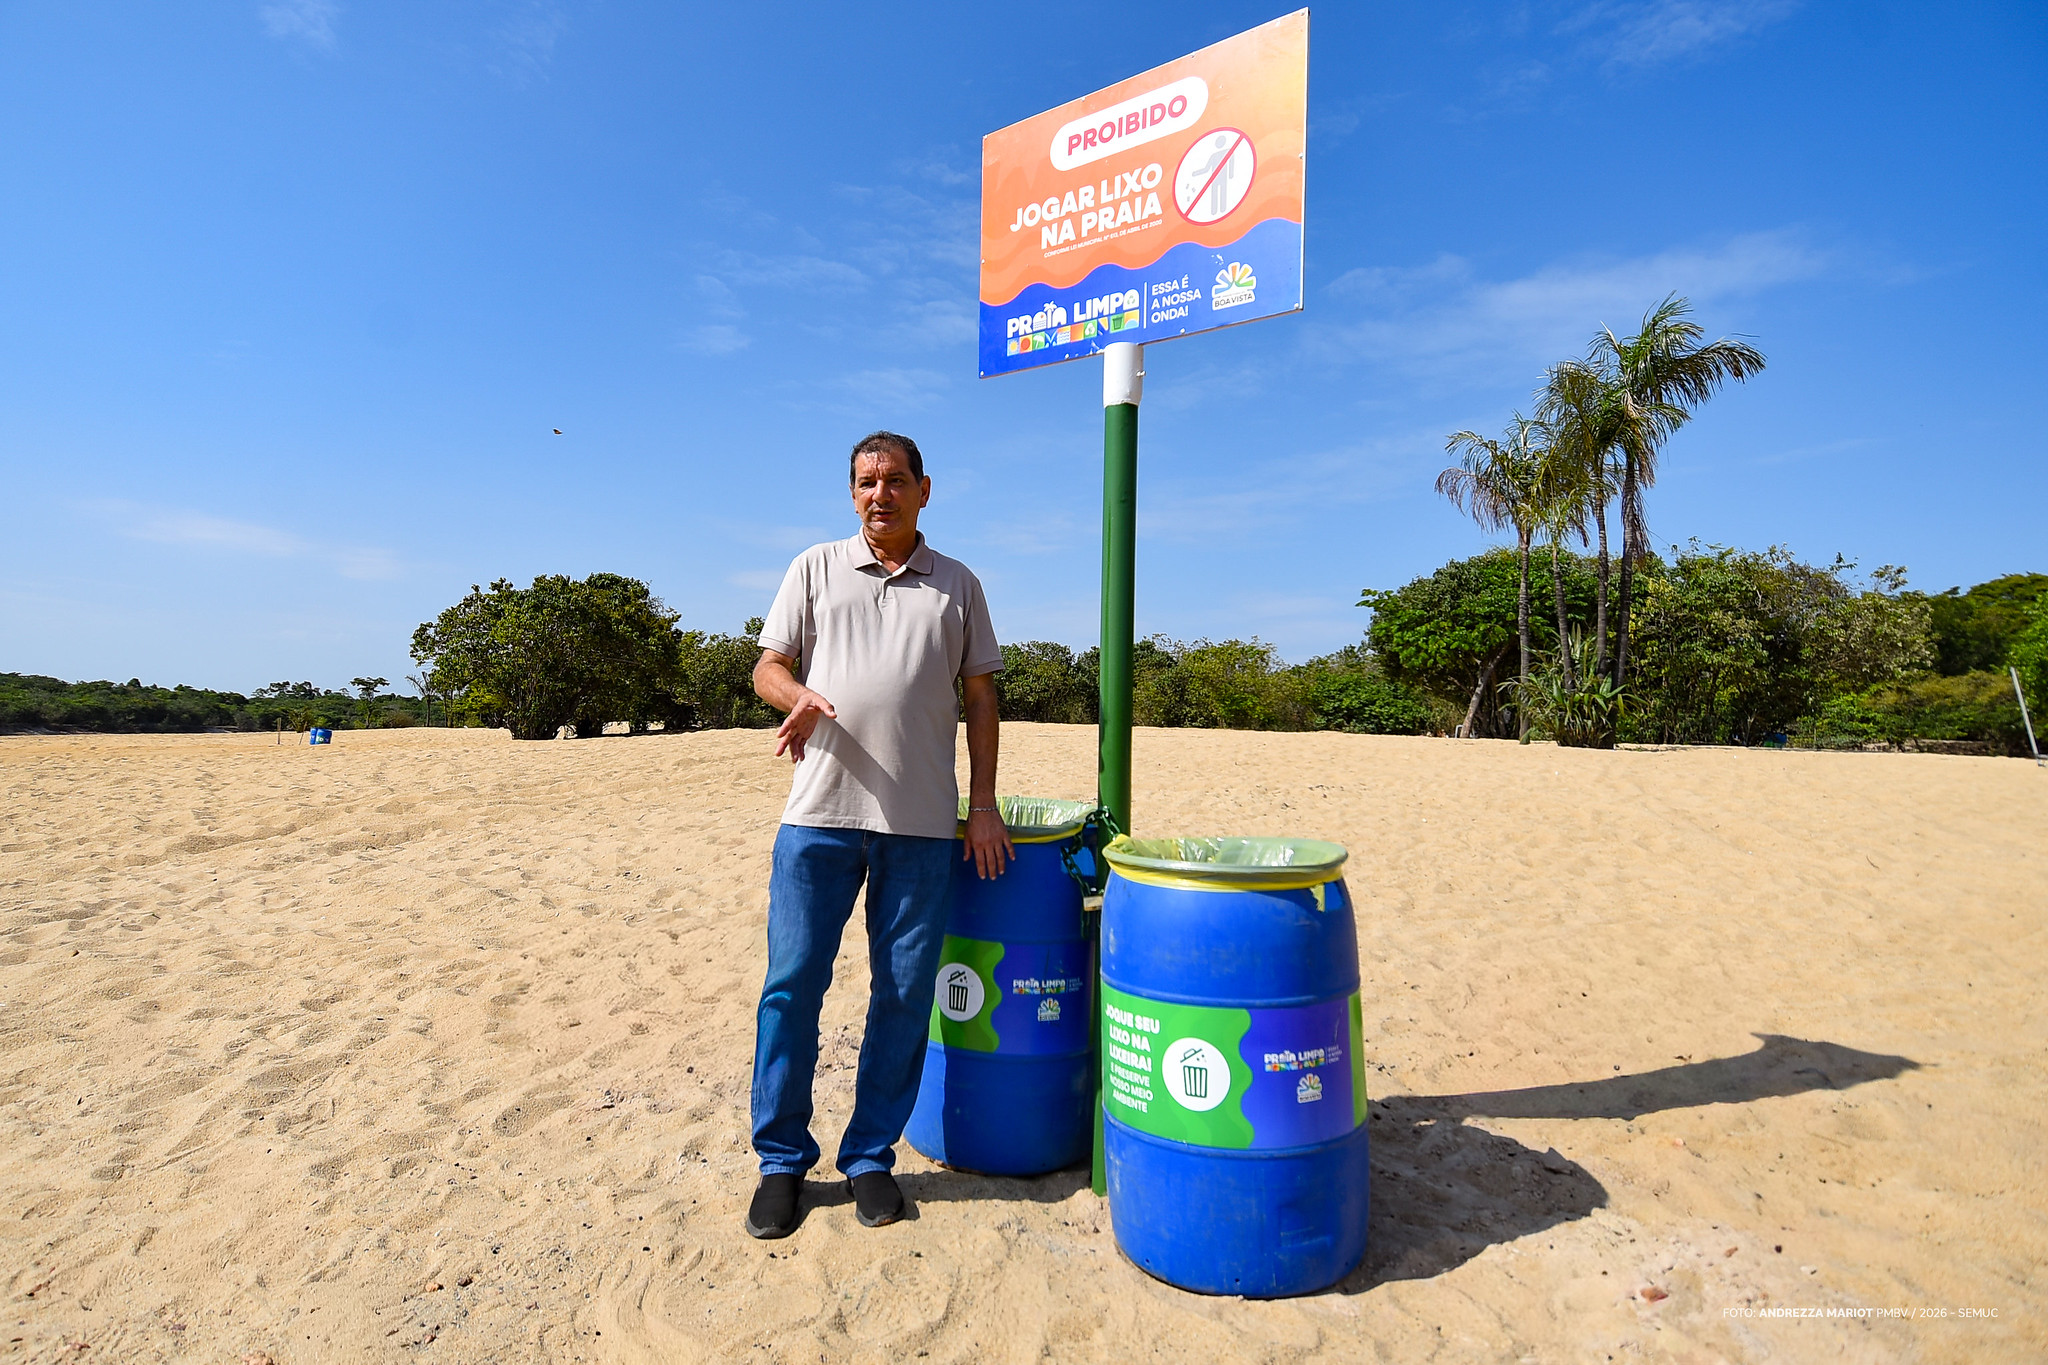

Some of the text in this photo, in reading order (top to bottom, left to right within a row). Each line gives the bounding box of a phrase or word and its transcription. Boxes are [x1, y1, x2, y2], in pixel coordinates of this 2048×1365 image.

[1067, 95, 1188, 156] PROIBIDO
[1009, 162, 1163, 232] JOGAR LIXO
[1041, 191, 1163, 250] NA PRAIA
[1141, 222, 1149, 230] DE
[1151, 274, 1189, 296] ESSA É
[1151, 300, 1160, 310] A
[1161, 288, 1202, 308] NOSSA
[1214, 298, 1231, 308] BOA
[1231, 293, 1253, 304] VISTA
[1007, 289, 1140, 339] PRAIA LIMPA
[1151, 306, 1189, 324] ONDA!
[1135, 1015, 1160, 1034] SEU
[1109, 1023, 1151, 1052] LIXO NA
[1109, 1042, 1152, 1072] LIXEIRA!
[1115, 1063, 1150, 1088] PRESERVE
[1112, 1088, 1148, 1113] AMBIENTE
[1131, 1084, 1154, 1101] MEIO
